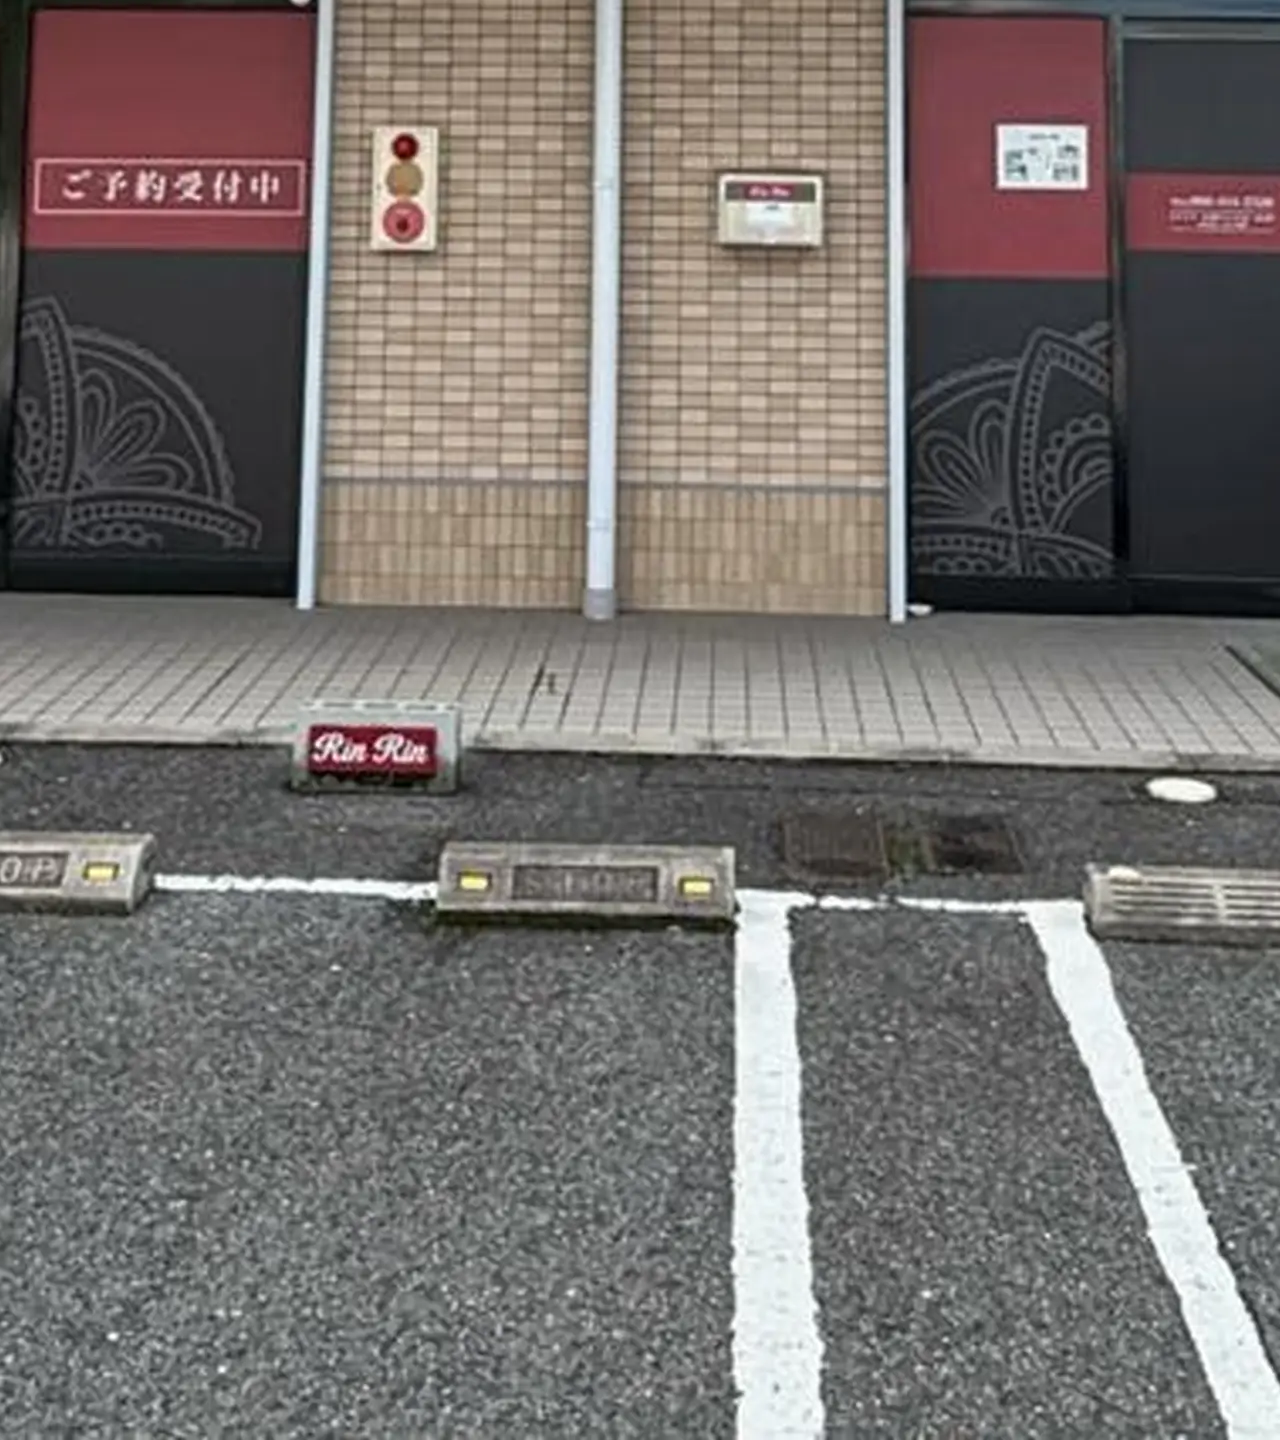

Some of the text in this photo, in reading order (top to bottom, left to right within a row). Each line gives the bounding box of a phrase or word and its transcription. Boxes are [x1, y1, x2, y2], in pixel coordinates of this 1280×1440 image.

[60, 168, 282, 204] ご予約受付中
[311, 731, 429, 764] Rin Rin
